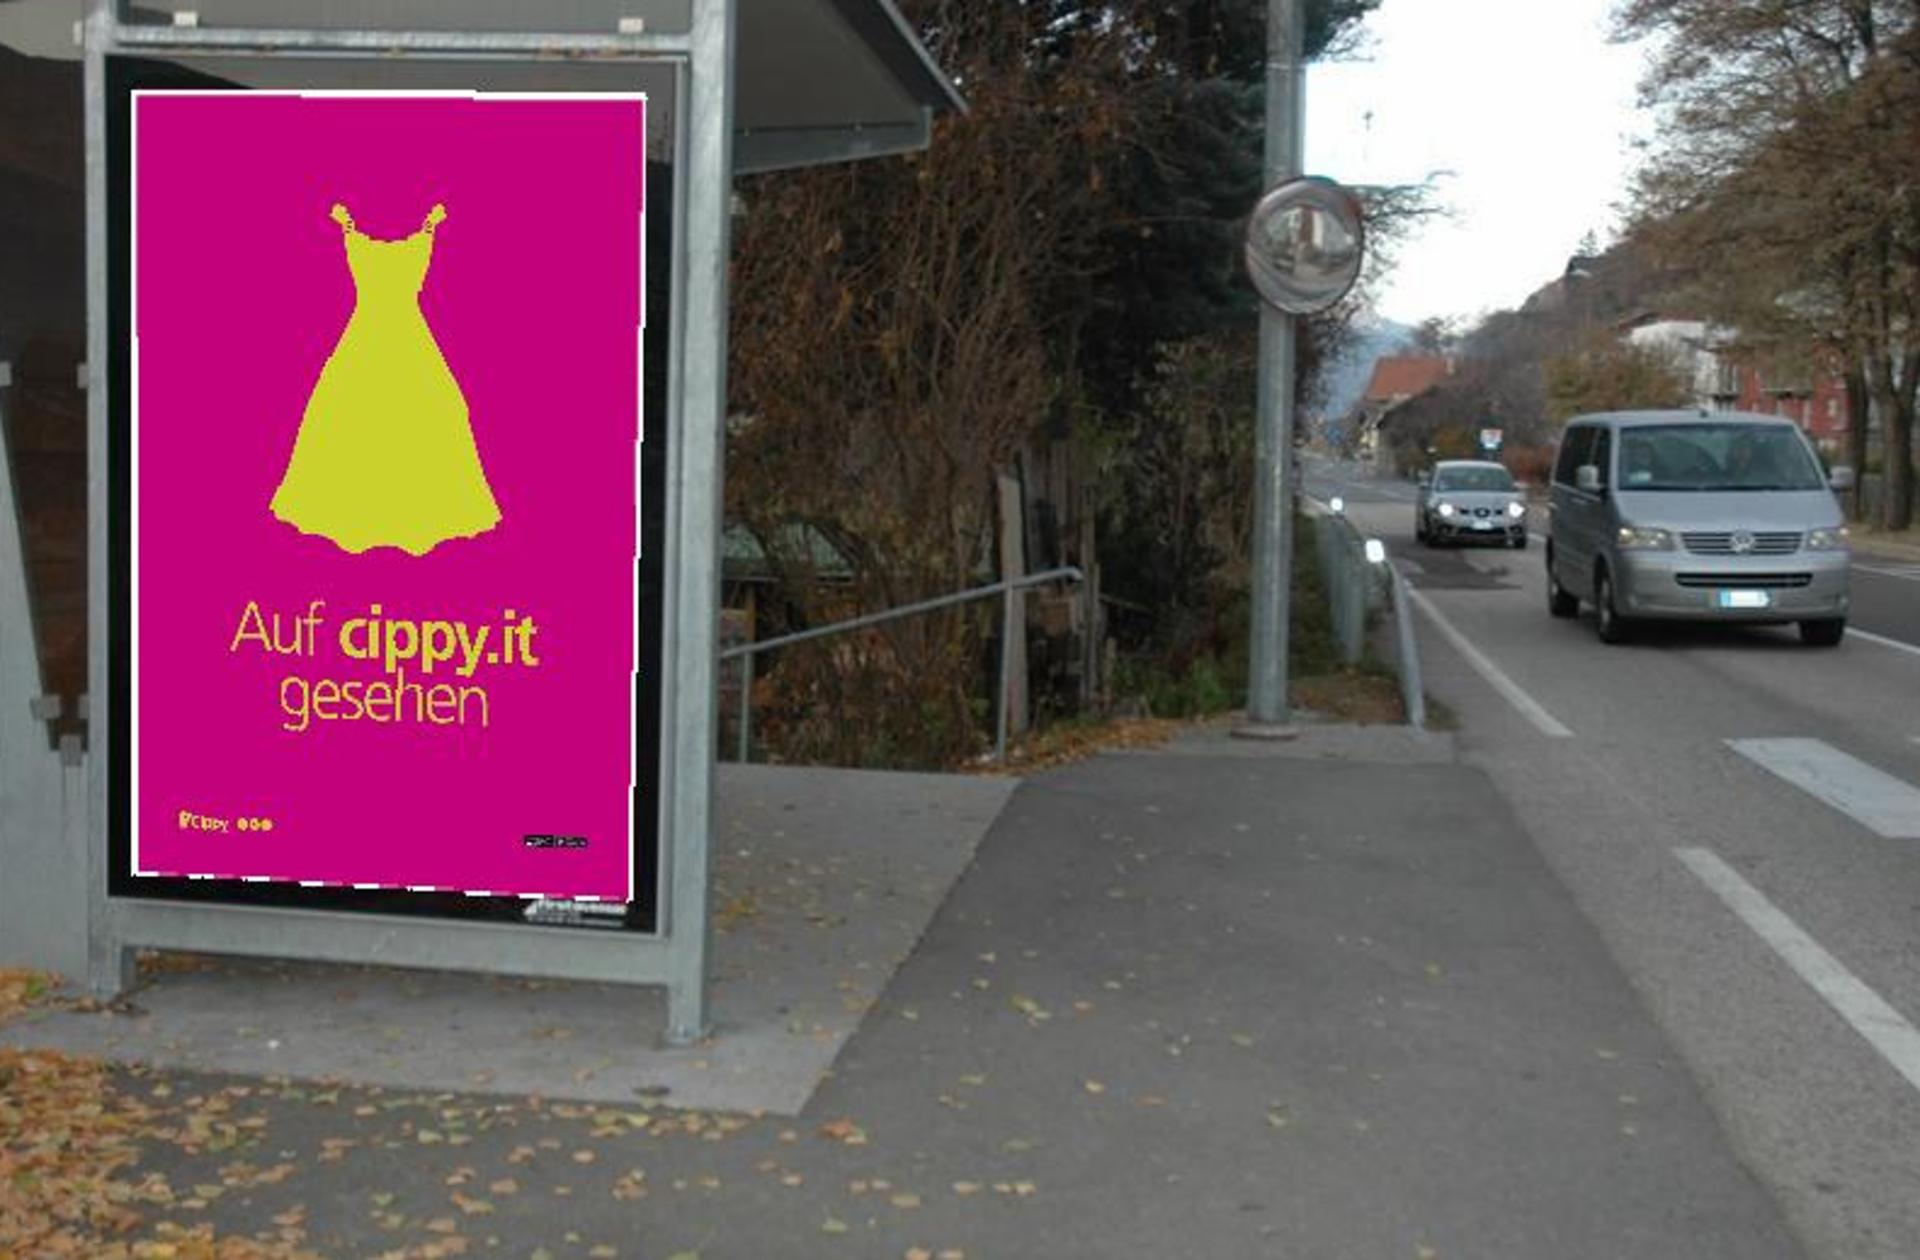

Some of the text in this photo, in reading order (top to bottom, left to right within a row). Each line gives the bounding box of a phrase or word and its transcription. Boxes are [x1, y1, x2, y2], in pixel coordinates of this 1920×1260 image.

[230, 600, 540, 678] Auf cippy.it
[279, 667, 489, 733] gesehen
